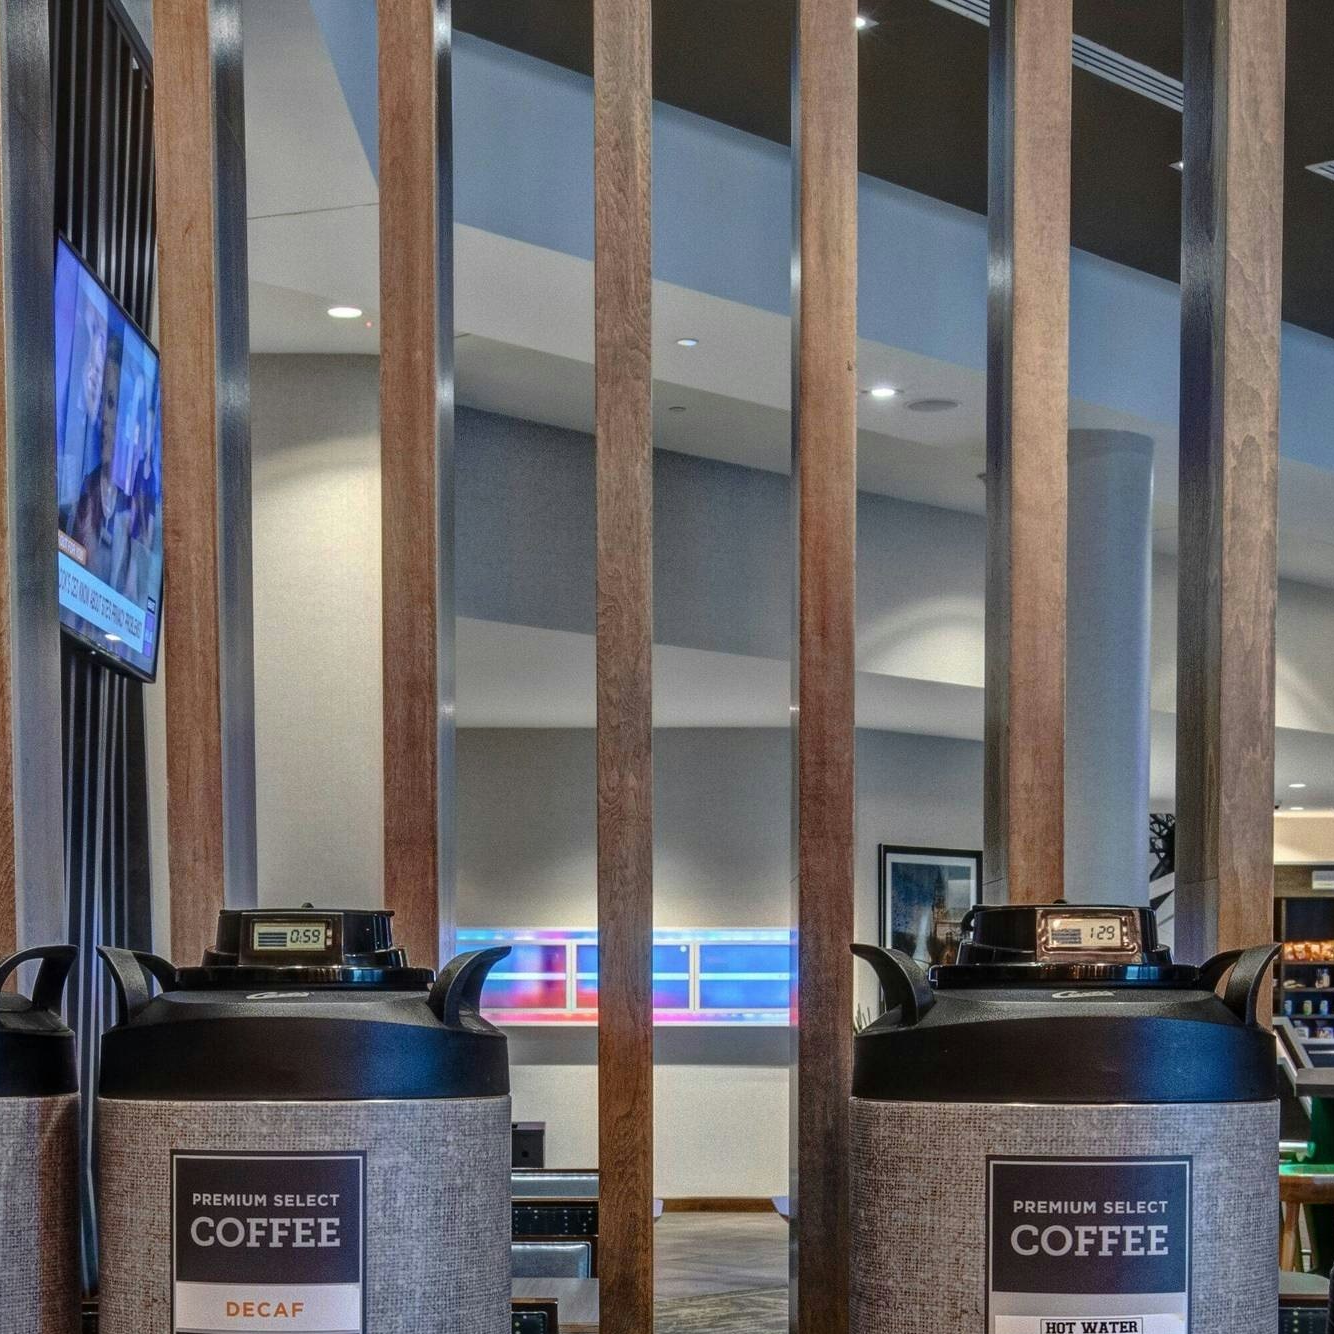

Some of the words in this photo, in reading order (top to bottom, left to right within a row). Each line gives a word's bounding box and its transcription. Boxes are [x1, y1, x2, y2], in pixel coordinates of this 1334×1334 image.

[289, 929, 321, 944] 0:59
[192, 1192, 267, 1207] PREMIUM
[273, 1194, 340, 1207] SELECT
[1013, 1200, 1097, 1214] PREMIUM
[1103, 1200, 1168, 1214] SELECT
[190, 1216, 341, 1248] COFFEE
[1010, 1224, 1169, 1257] COFFEE
[226, 1301, 305, 1318] DECAF
[1045, 1321, 1076, 1334] HOT
[1082, 1320, 1138, 1334] WATER
